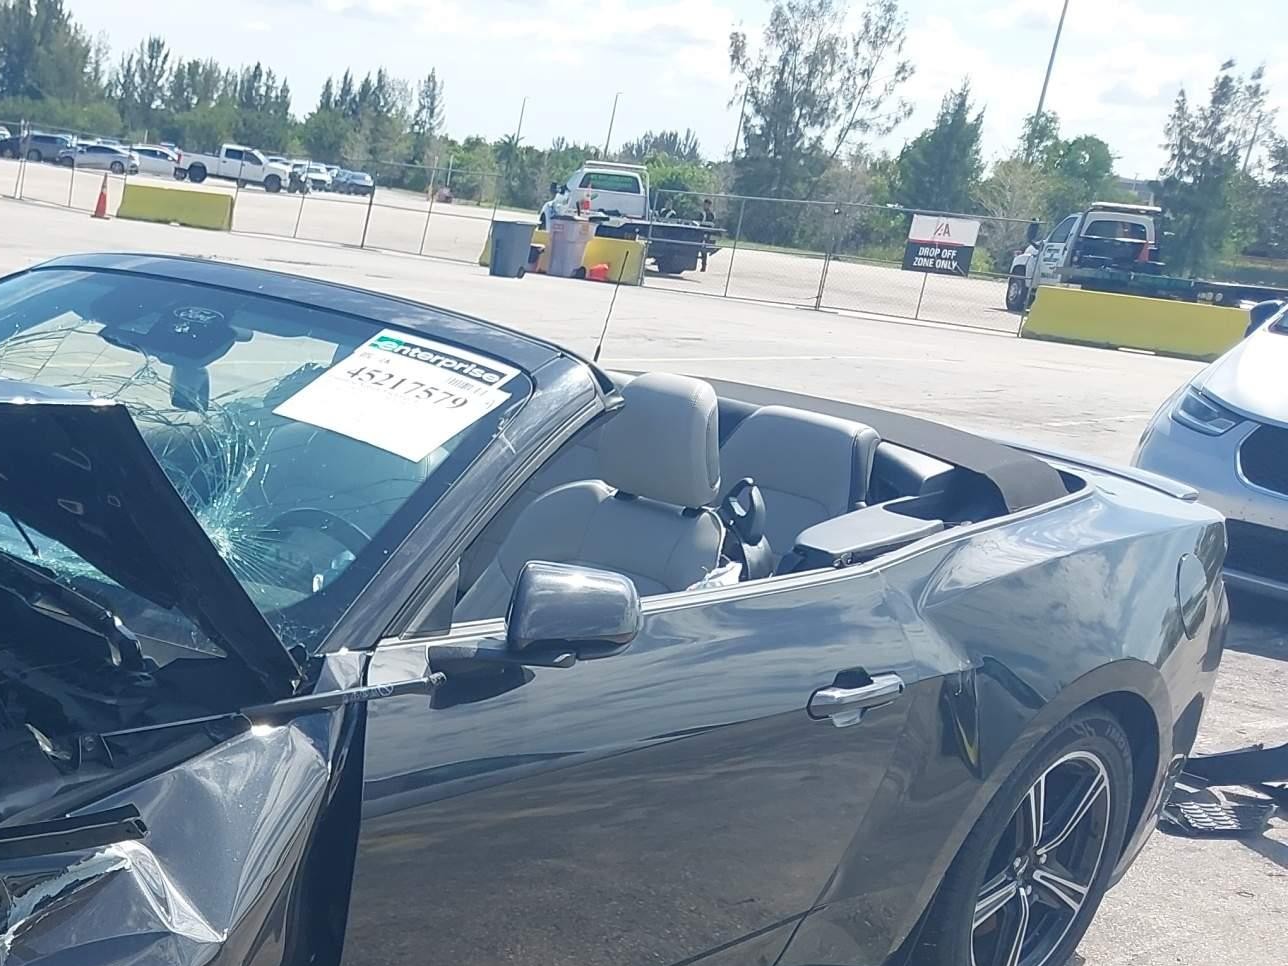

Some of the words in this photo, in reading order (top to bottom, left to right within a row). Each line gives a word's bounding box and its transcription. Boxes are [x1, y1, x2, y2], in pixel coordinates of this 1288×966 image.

[912, 256, 935, 268] ZONE
[935, 259, 958, 270] ONLY
[918, 247, 940, 258] DROP
[941, 249, 957, 259] OFF
[378, 338, 501, 384] enterprise
[346, 365, 468, 409] 45217579
